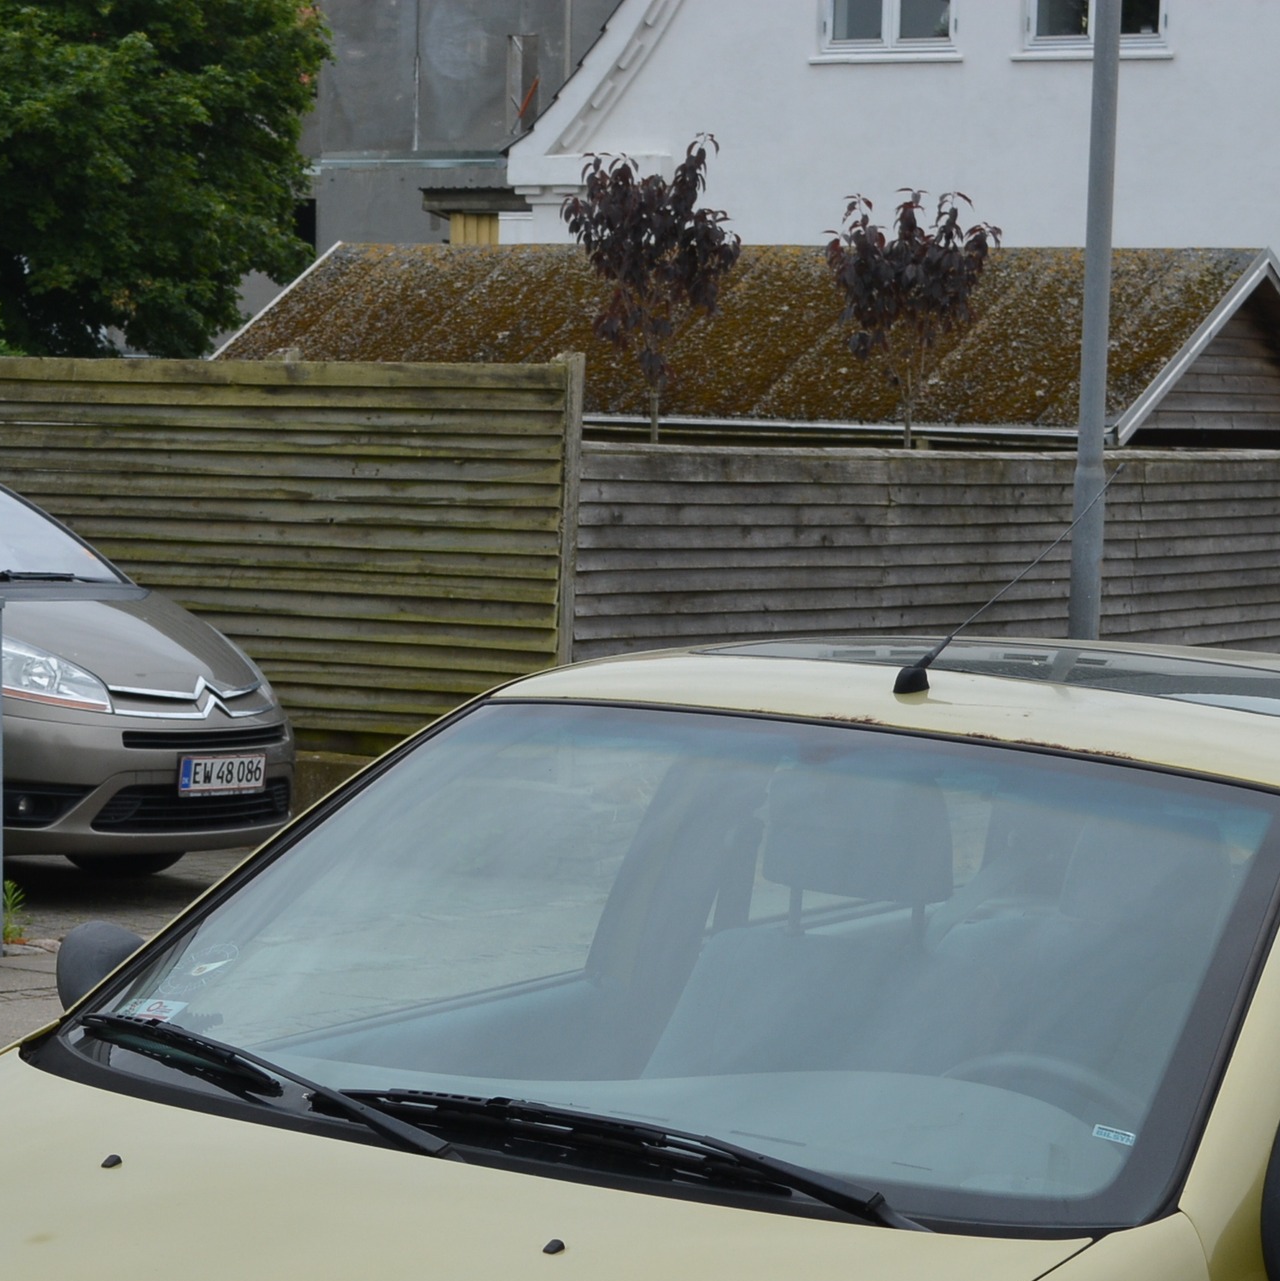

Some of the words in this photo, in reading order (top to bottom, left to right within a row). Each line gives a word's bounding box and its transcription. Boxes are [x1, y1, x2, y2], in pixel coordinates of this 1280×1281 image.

[192, 762, 214, 784] EW
[216, 760, 234, 784] 48
[237, 759, 262, 783] 086
